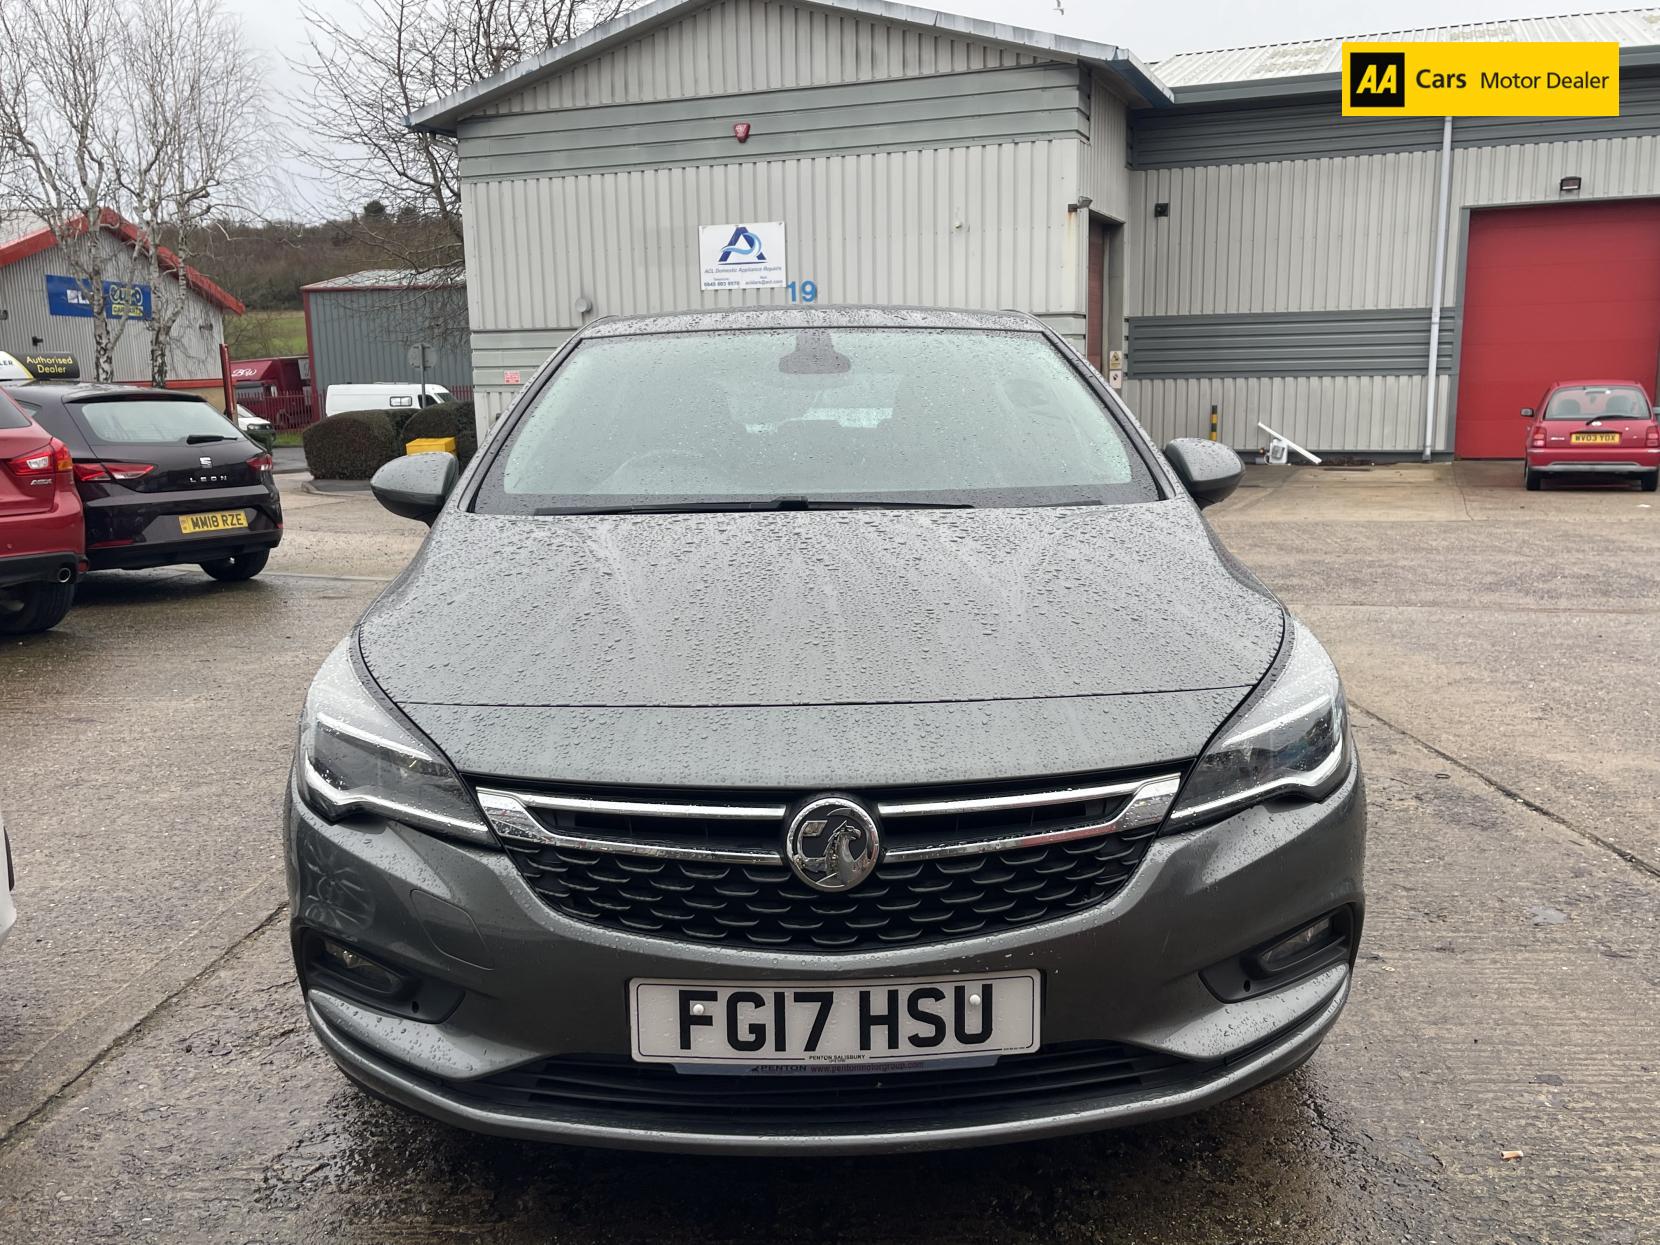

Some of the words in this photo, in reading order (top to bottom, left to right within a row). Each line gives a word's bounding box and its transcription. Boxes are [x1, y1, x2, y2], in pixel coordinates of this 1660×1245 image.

[787, 280, 817, 303] 19
[26, 355, 73, 365] Authorised
[37, 364, 66, 374] Dealer
[189, 475, 227, 483] LEON
[190, 515, 219, 530] MM18
[221, 513, 244, 528] RZE
[678, 989, 834, 1053] FG17
[859, 983, 993, 1051] HSU
[760, 1064, 807, 1072] PENTON
